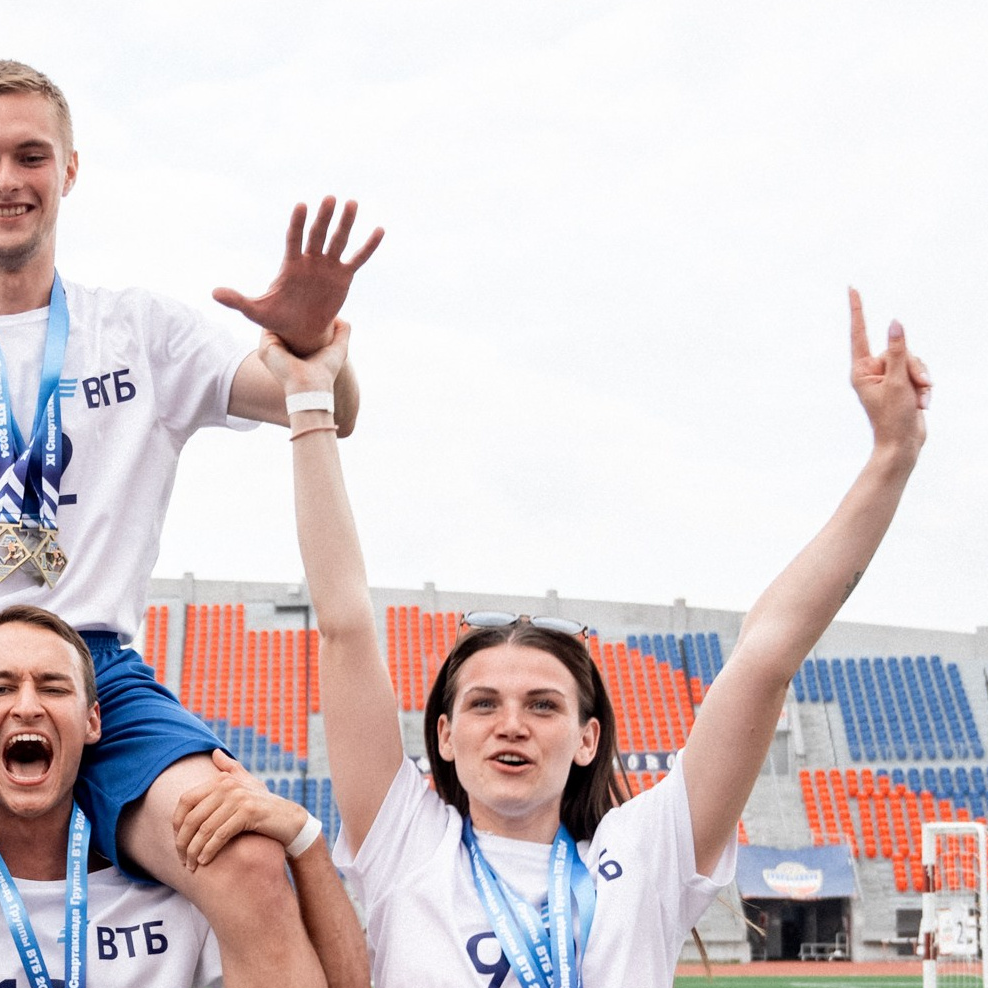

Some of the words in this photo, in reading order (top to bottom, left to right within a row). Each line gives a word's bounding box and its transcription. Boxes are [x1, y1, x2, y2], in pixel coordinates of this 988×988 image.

[82, 368, 136, 409] ВТБ
[71, 831, 82, 858] ВТБ
[70, 860, 82, 906] Группы
[9, 902, 32, 949] Группы
[25, 948, 44, 976] ВТБ
[95, 919, 170, 961] ВТБ
[535, 944, 554, 974] ВТБ
[515, 955, 536, 983] ВТБ
